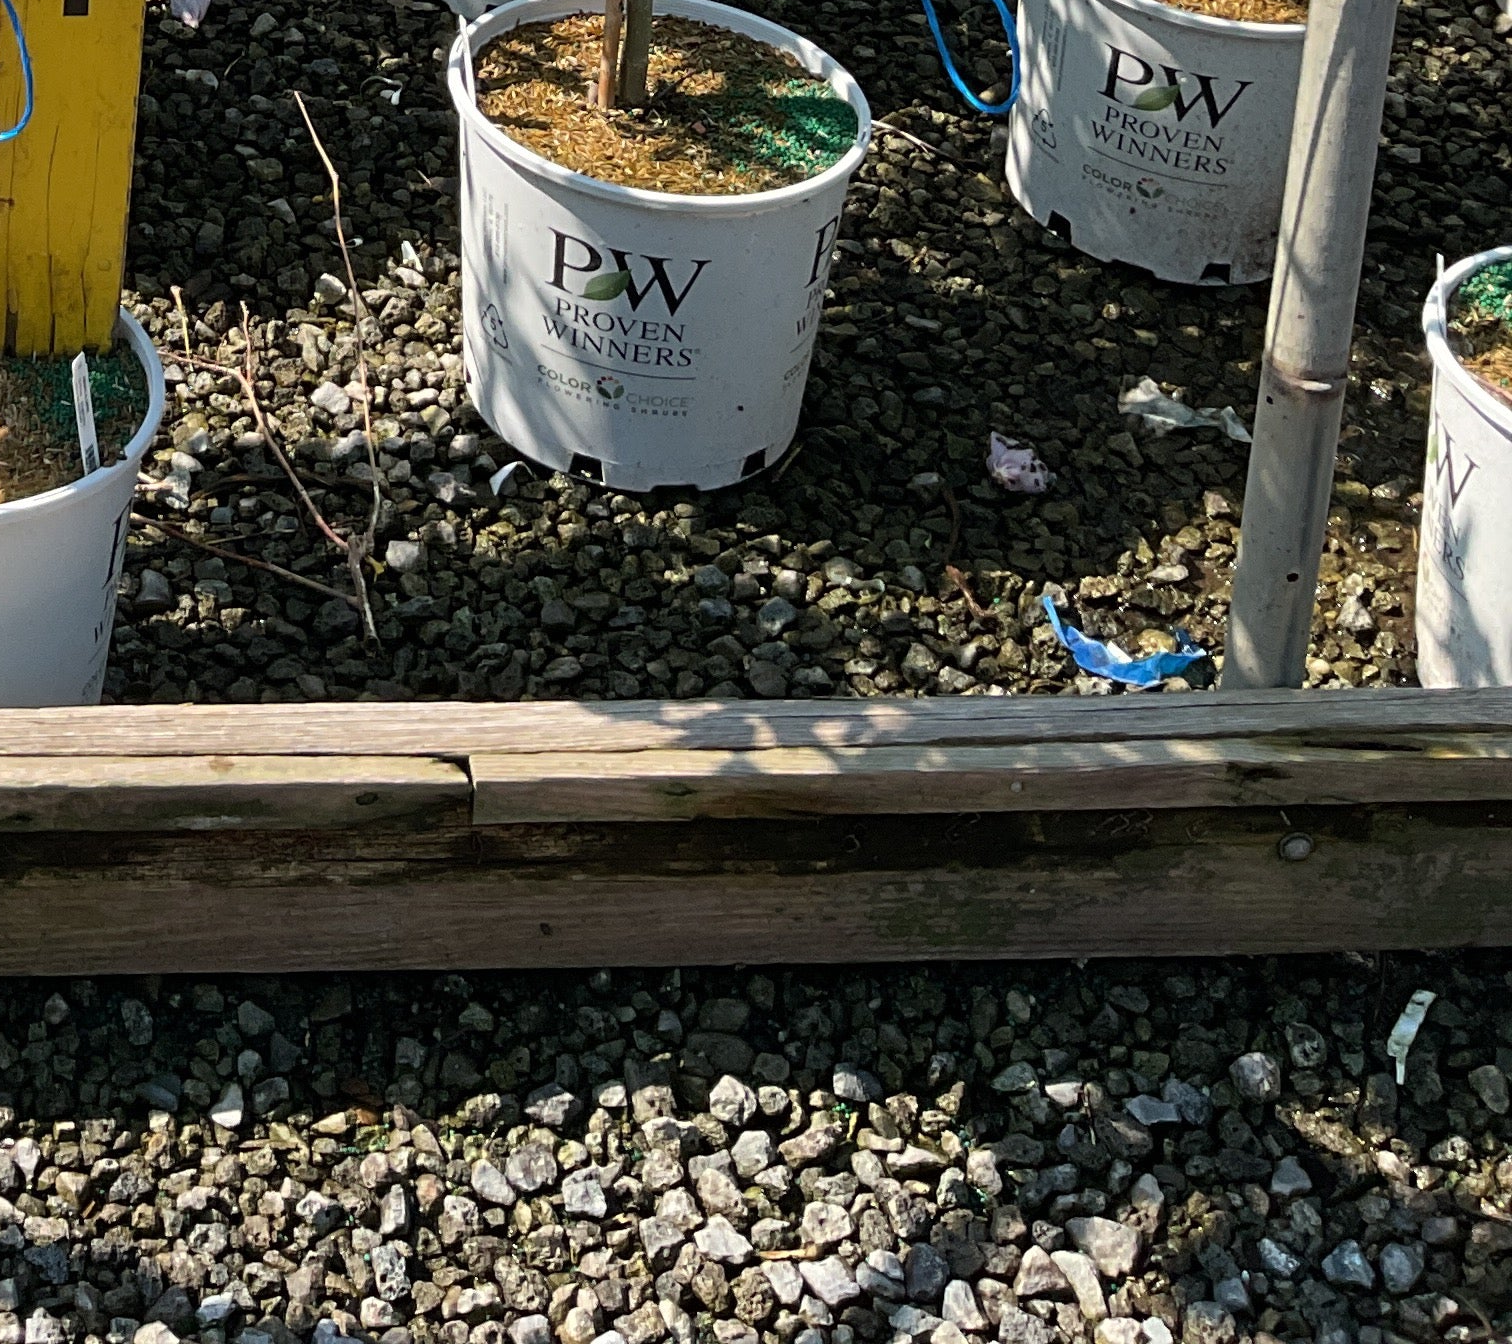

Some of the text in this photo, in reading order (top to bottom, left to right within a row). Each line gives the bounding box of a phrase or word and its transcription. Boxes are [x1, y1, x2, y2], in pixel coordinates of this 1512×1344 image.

[1097, 42, 1254, 129] PW
[1090, 120, 1228, 175] WINNERS
[1105, 105, 1225, 153] PROVEN
[1082, 163, 1132, 192] COLOR
[545, 227, 712, 317] PW
[542, 314, 693, 367] WINNERS
[555, 297, 686, 344] PROVEN
[537, 364, 688, 408] COLOR CHOICE
